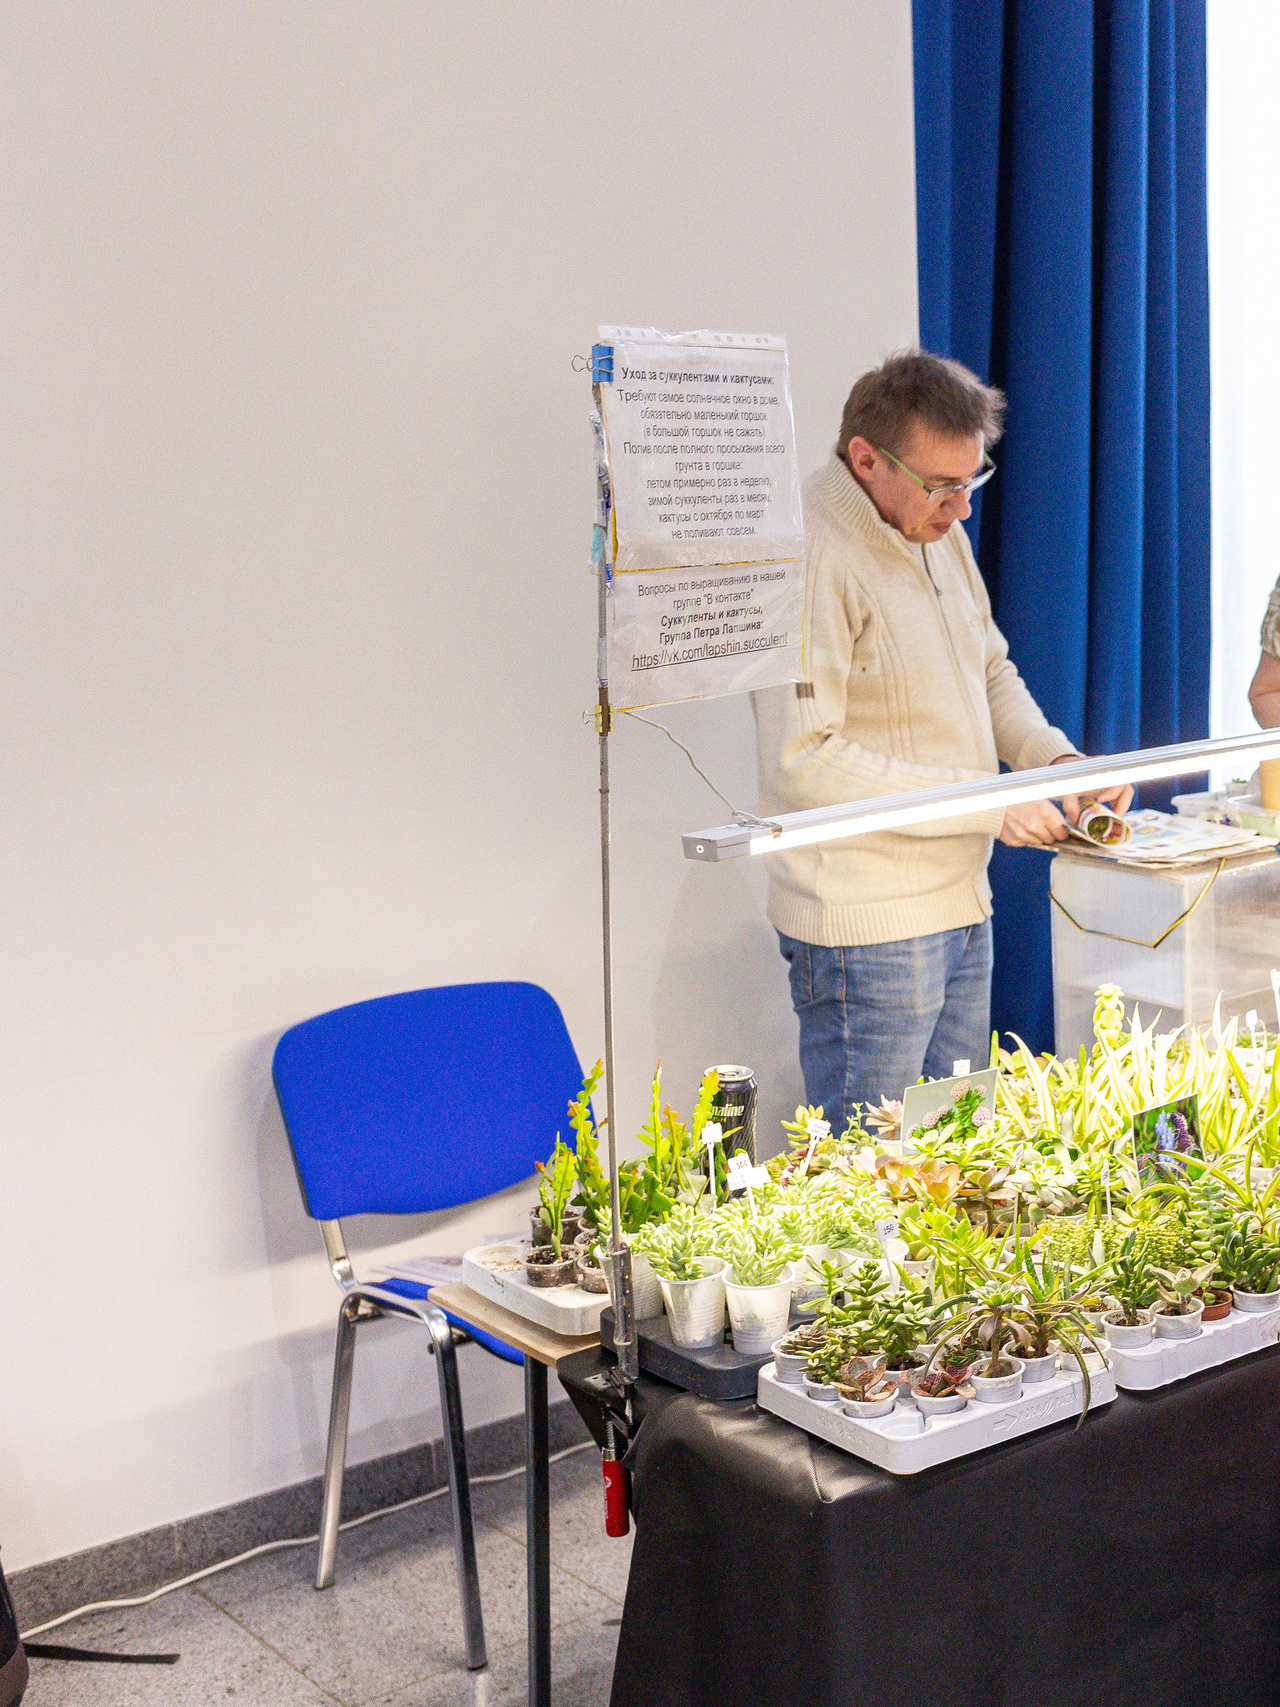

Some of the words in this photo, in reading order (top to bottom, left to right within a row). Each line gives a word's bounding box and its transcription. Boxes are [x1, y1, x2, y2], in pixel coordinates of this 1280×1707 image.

[621, 367, 646, 381] Уход
[648, 371, 657, 380] за
[659, 371, 720, 384] суккулентами
[722, 375, 729, 383] и
[730, 375, 775, 387] кактусами:
[617, 389, 657, 404] Требуют
[658, 393, 684, 402] самое
[686, 394, 731, 404] солнечное
[732, 395, 752, 405] окно
[753, 396, 758, 405] в
[640, 407, 692, 420] обязательно
[693, 409, 739, 421] маленький
[740, 411, 768, 424] горшок
[643, 425, 651, 439] (в
[652, 425, 690, 437] большой
[691, 427, 722, 439] горшок
[723, 428, 734, 437] не
[623, 441, 652, 454] Полив
[653, 444, 679, 454] после
[680, 444, 714, 454] полного
[716, 444, 765, 456] просыхания
[765, 444, 786, 454] всего
[675, 461, 703, 474] грунта
[705, 461, 711, 471] в
[646, 479, 672, 489] летом
[673, 478, 716, 490] примерно
[717, 478, 732, 489] раз
[648, 494, 673, 507] зимой
[674, 495, 723, 508] суккуленты
[724, 494, 739, 506] раз
[740, 494, 745, 503] в
[658, 512, 692, 525] кактусы
[693, 512, 699, 521] с
[700, 508, 733, 522] октября
[735, 511, 745, 519] по
[746, 509, 765, 520] март
[671, 529, 683, 539] не
[638, 584, 676, 597] Вопросы
[678, 582, 688, 591] по
[691, 576, 751, 591] выращиванию
[753, 573, 758, 582] в
[759, 570, 786, 581] нашей
[673, 597, 701, 610] группе
[715, 589, 754, 603] контакте"
[661, 610, 716, 628] Суккуленты
[718, 610, 724, 618] и
[726, 606, 763, 618] кактусы,
[660, 628, 691, 644] Группа
[694, 626, 720, 639] Петра
[722, 621, 764, 635] Лапшина:
[632, 632, 788, 669] https://vk.com/lapshin.succulent
[711, 1103, 745, 1116] naline
